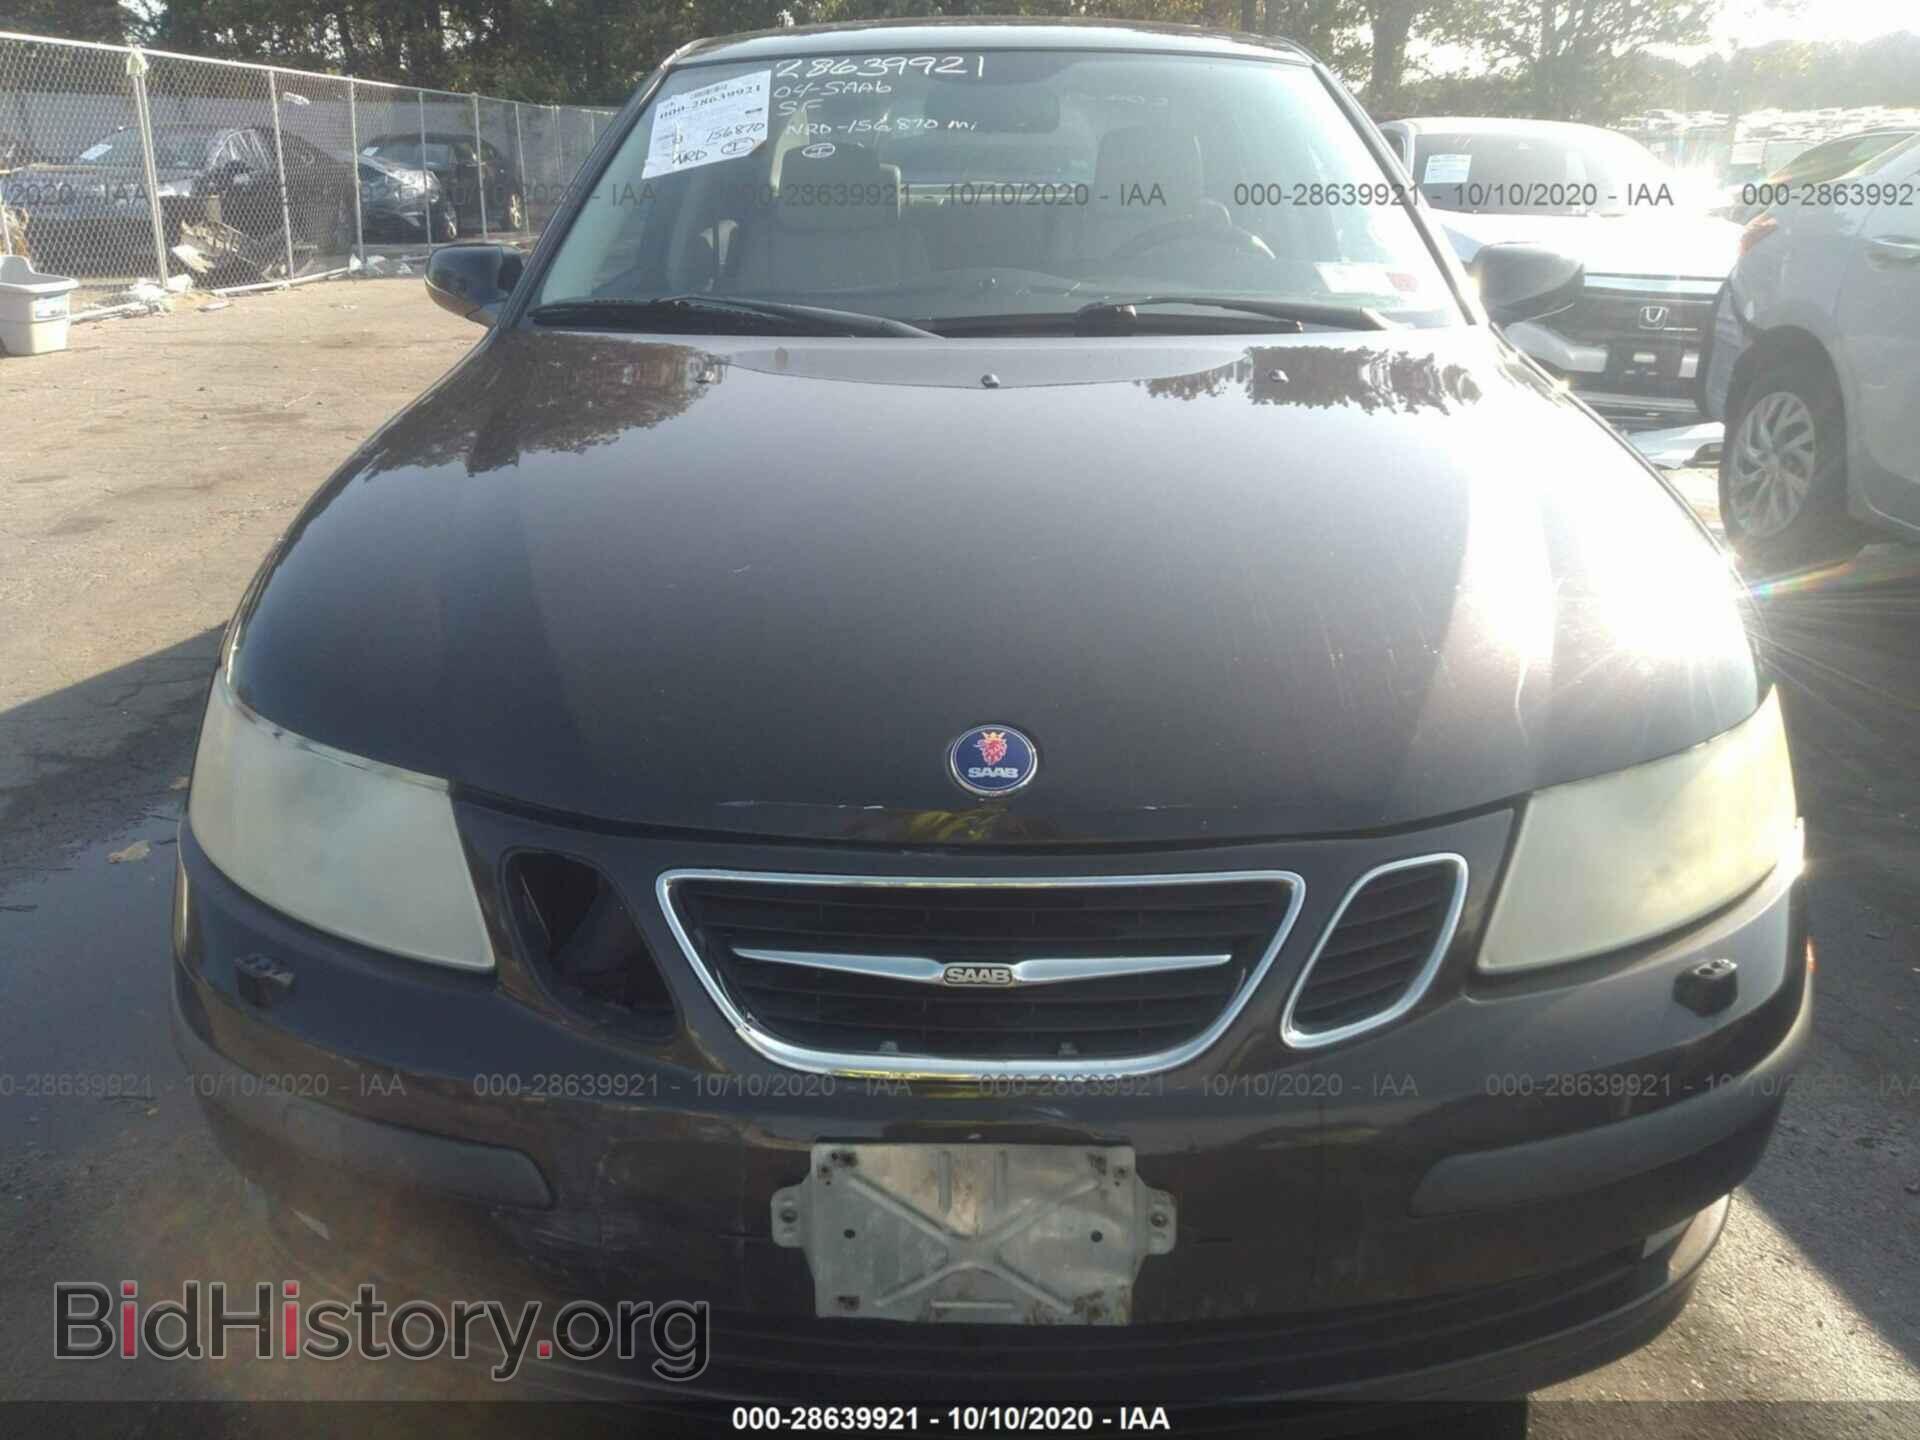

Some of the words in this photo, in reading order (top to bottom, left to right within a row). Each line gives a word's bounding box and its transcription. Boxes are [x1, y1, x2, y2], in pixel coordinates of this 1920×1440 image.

[776, 56, 985, 78] 28639921
[777, 99, 824, 116] SF
[968, 767, 1019, 779] SAAB
[946, 967, 1012, 984] SAAB
